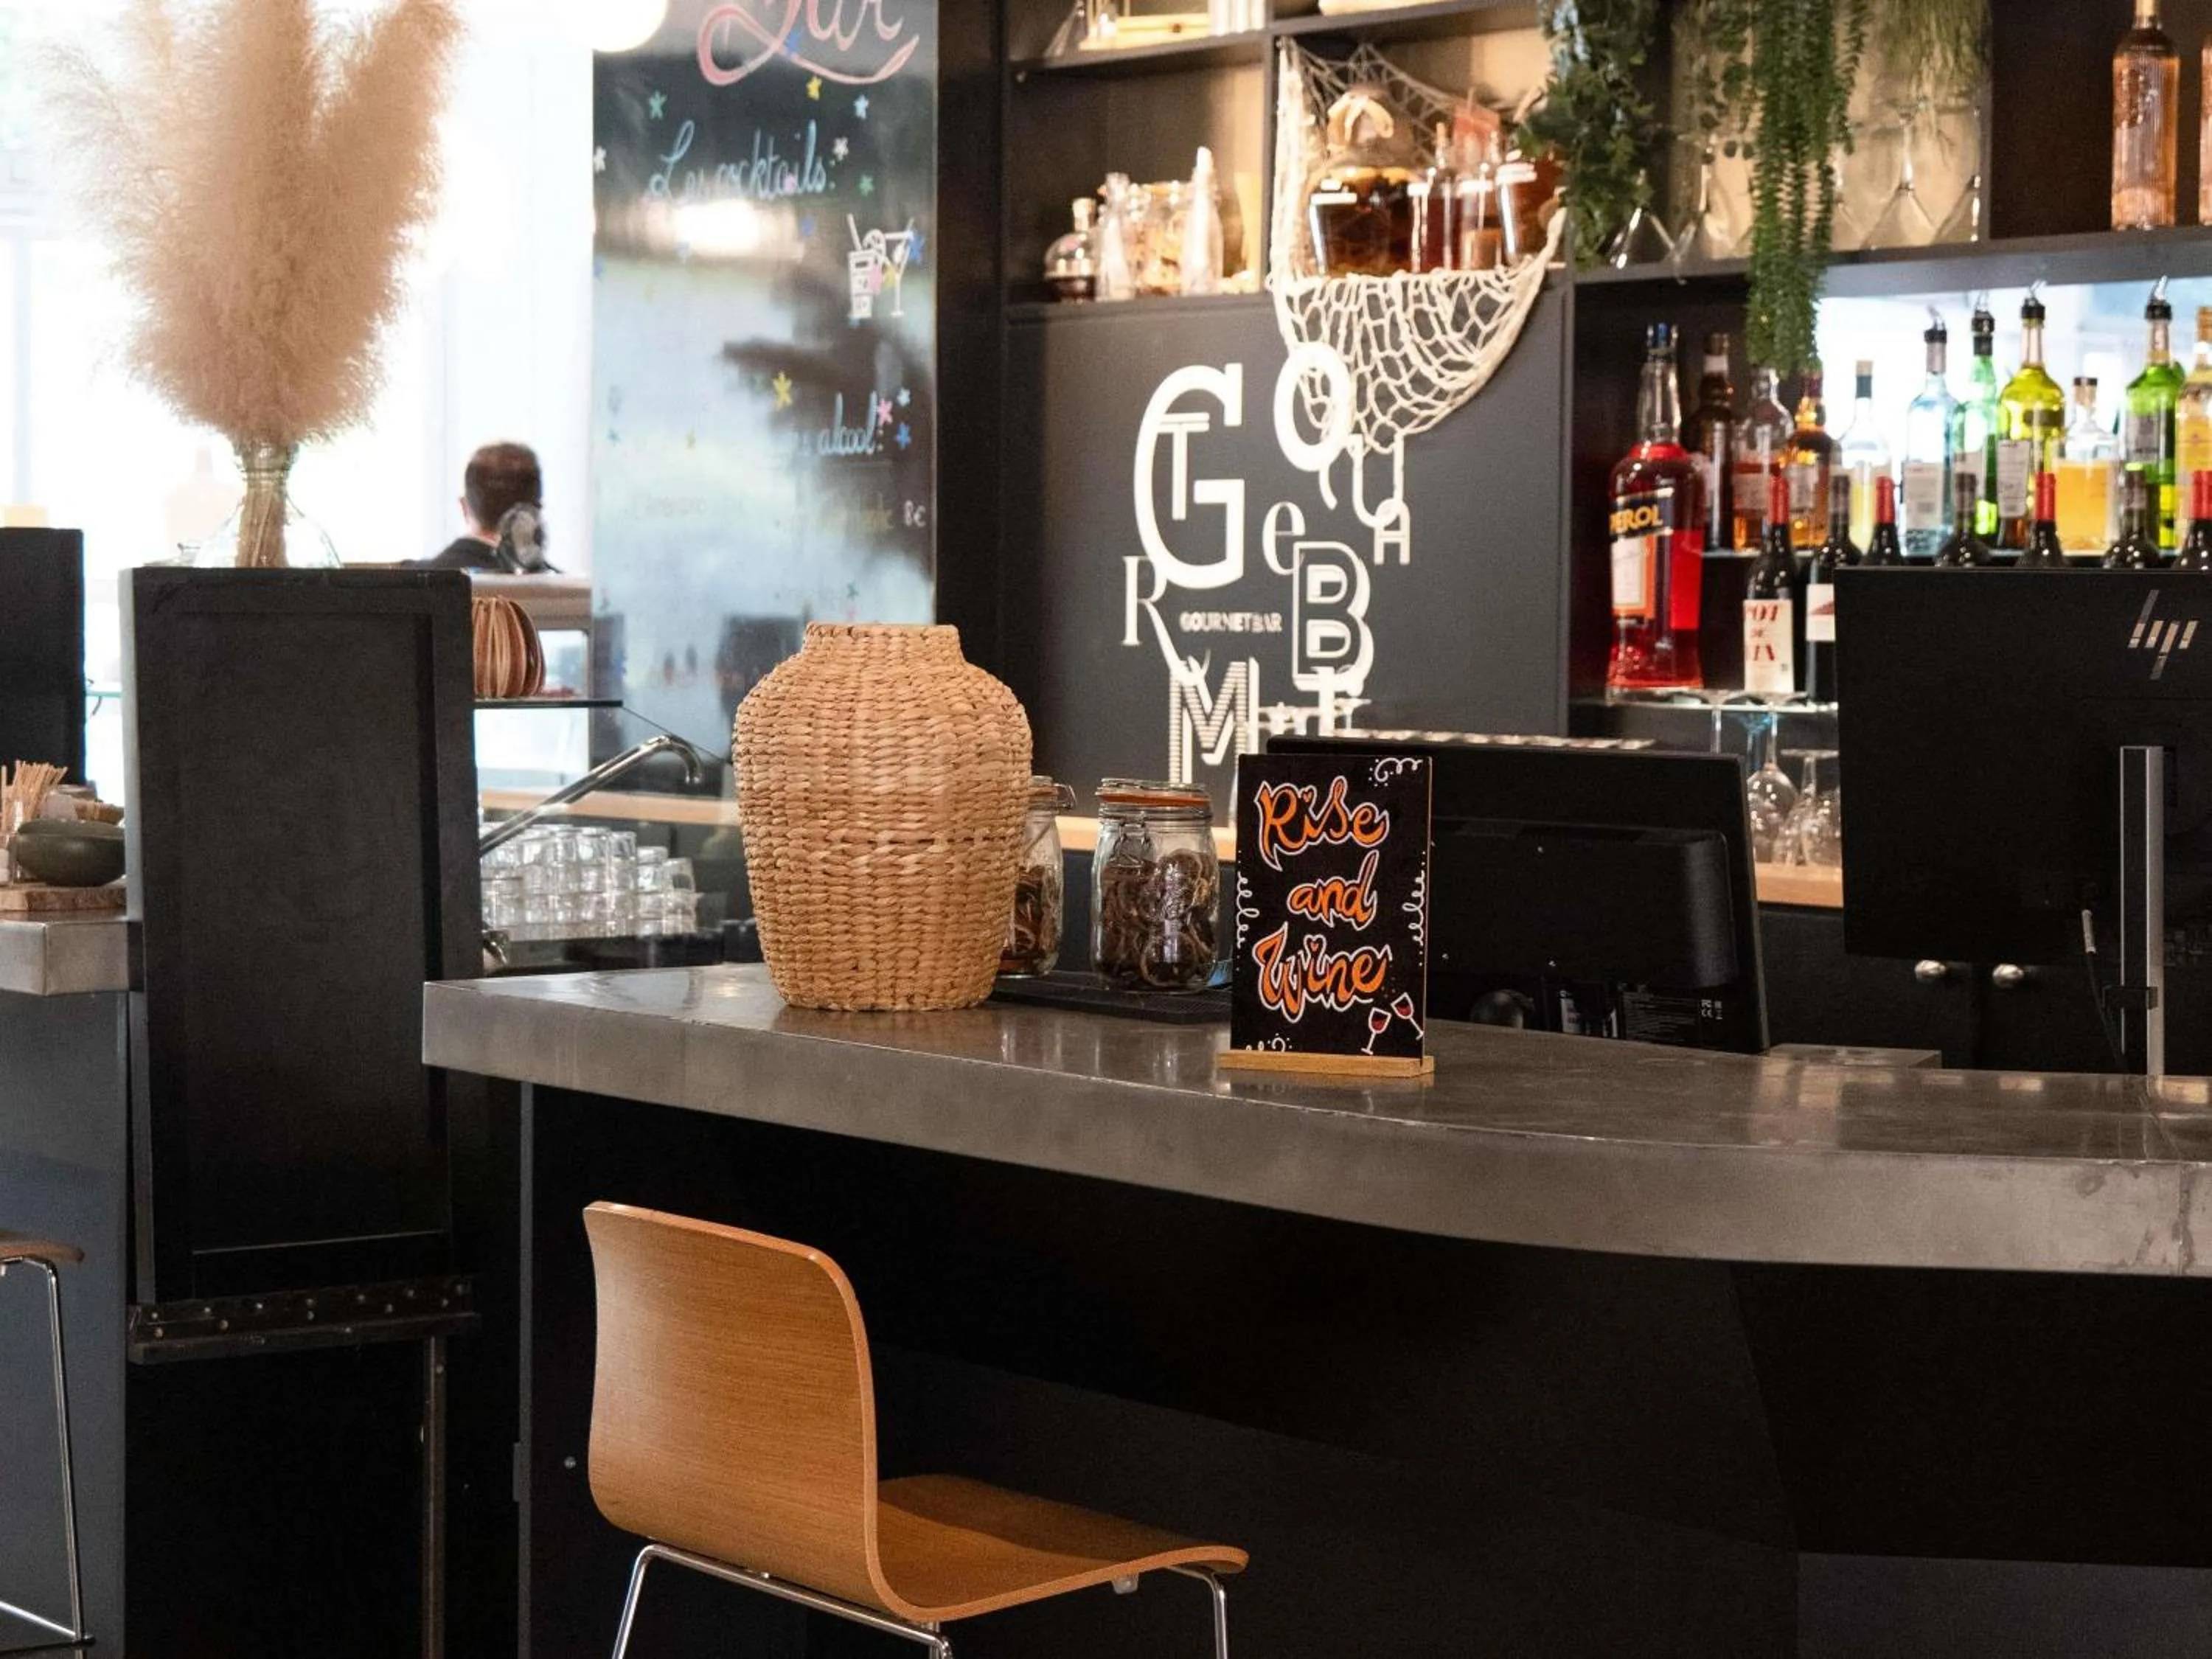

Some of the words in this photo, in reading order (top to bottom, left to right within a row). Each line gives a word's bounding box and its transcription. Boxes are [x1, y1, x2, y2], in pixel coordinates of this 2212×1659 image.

[1610, 504, 1663, 534] EROL
[2127, 589, 2199, 681] hp
[1254, 775, 1390, 872] Rise
[1287, 849, 1380, 931] and
[1253, 921, 1392, 1023] Wine
